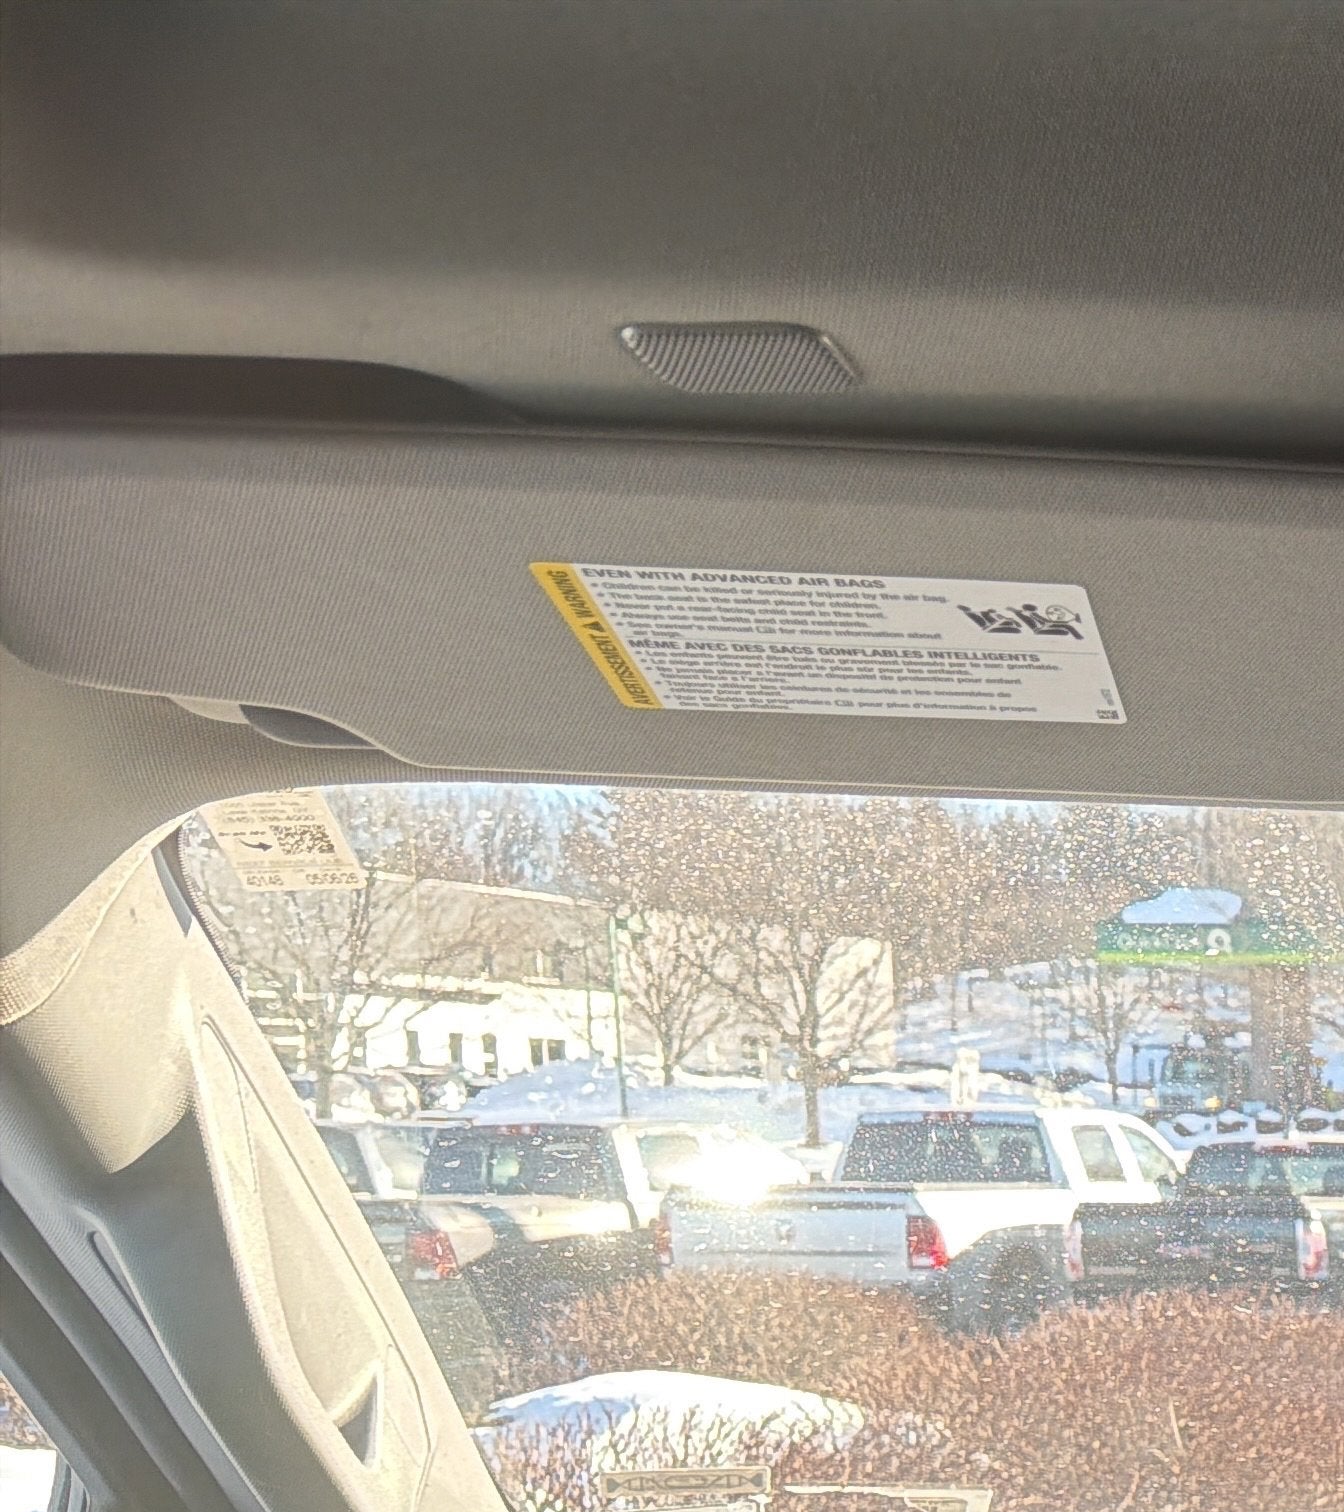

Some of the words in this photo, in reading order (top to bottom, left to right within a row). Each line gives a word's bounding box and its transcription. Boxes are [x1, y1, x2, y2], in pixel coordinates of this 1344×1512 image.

[547, 570, 595, 618] WARNING
[581, 567, 633, 579] EVEN
[633, 570, 687, 581] WITH
[687, 572, 794, 585] ADVANCED
[795, 576, 831, 587] AIR
[832, 578, 886, 589] BAGS
[627, 639, 682, 649] MÊME
[681, 641, 729, 651] AVEC
[730, 643, 766, 652] DES
[767, 644, 814, 654] SACS
[816, 646, 923, 658] GONFLABLES
[926, 650, 1040, 662] INTELLIGENTS
[590, 633, 654, 705] AVERTISSEMENT
